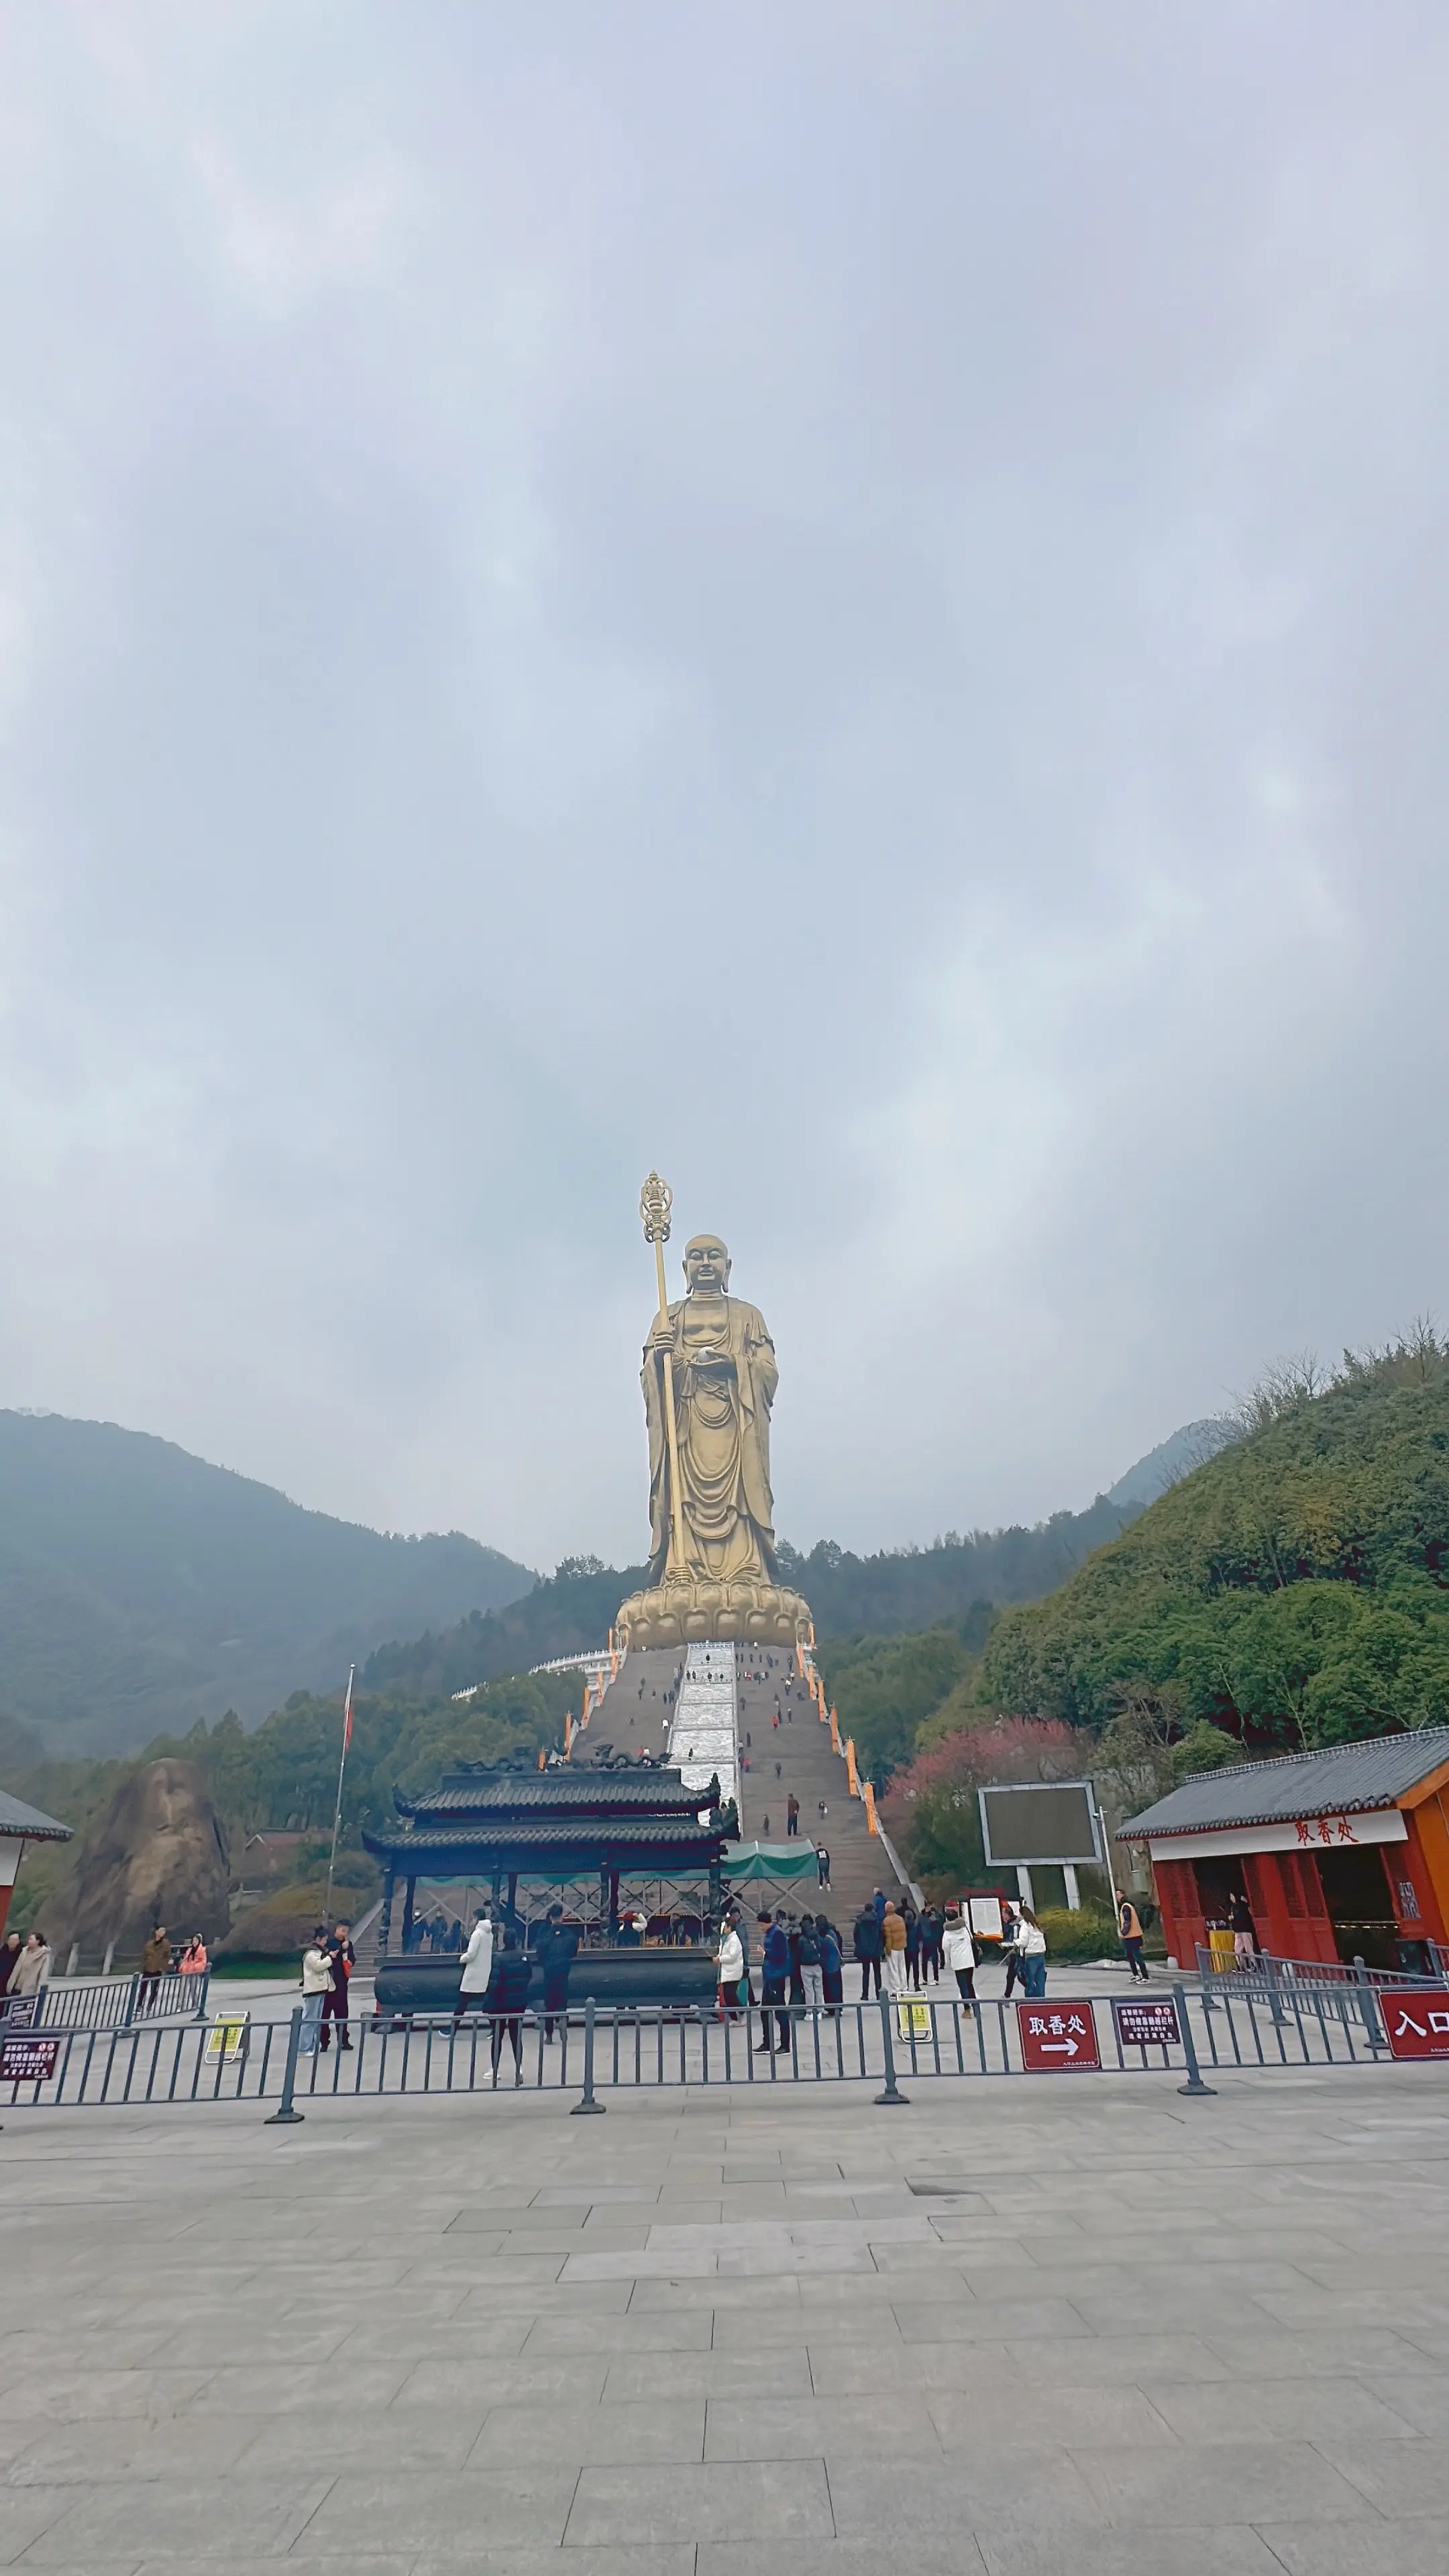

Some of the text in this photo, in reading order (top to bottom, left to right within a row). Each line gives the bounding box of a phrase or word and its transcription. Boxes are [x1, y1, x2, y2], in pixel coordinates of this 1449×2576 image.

[1294, 1816, 1358, 1846] 取香处
[1029, 2015, 1087, 2035] 取香处
[1395, 2010, 1449, 2037] 入口
